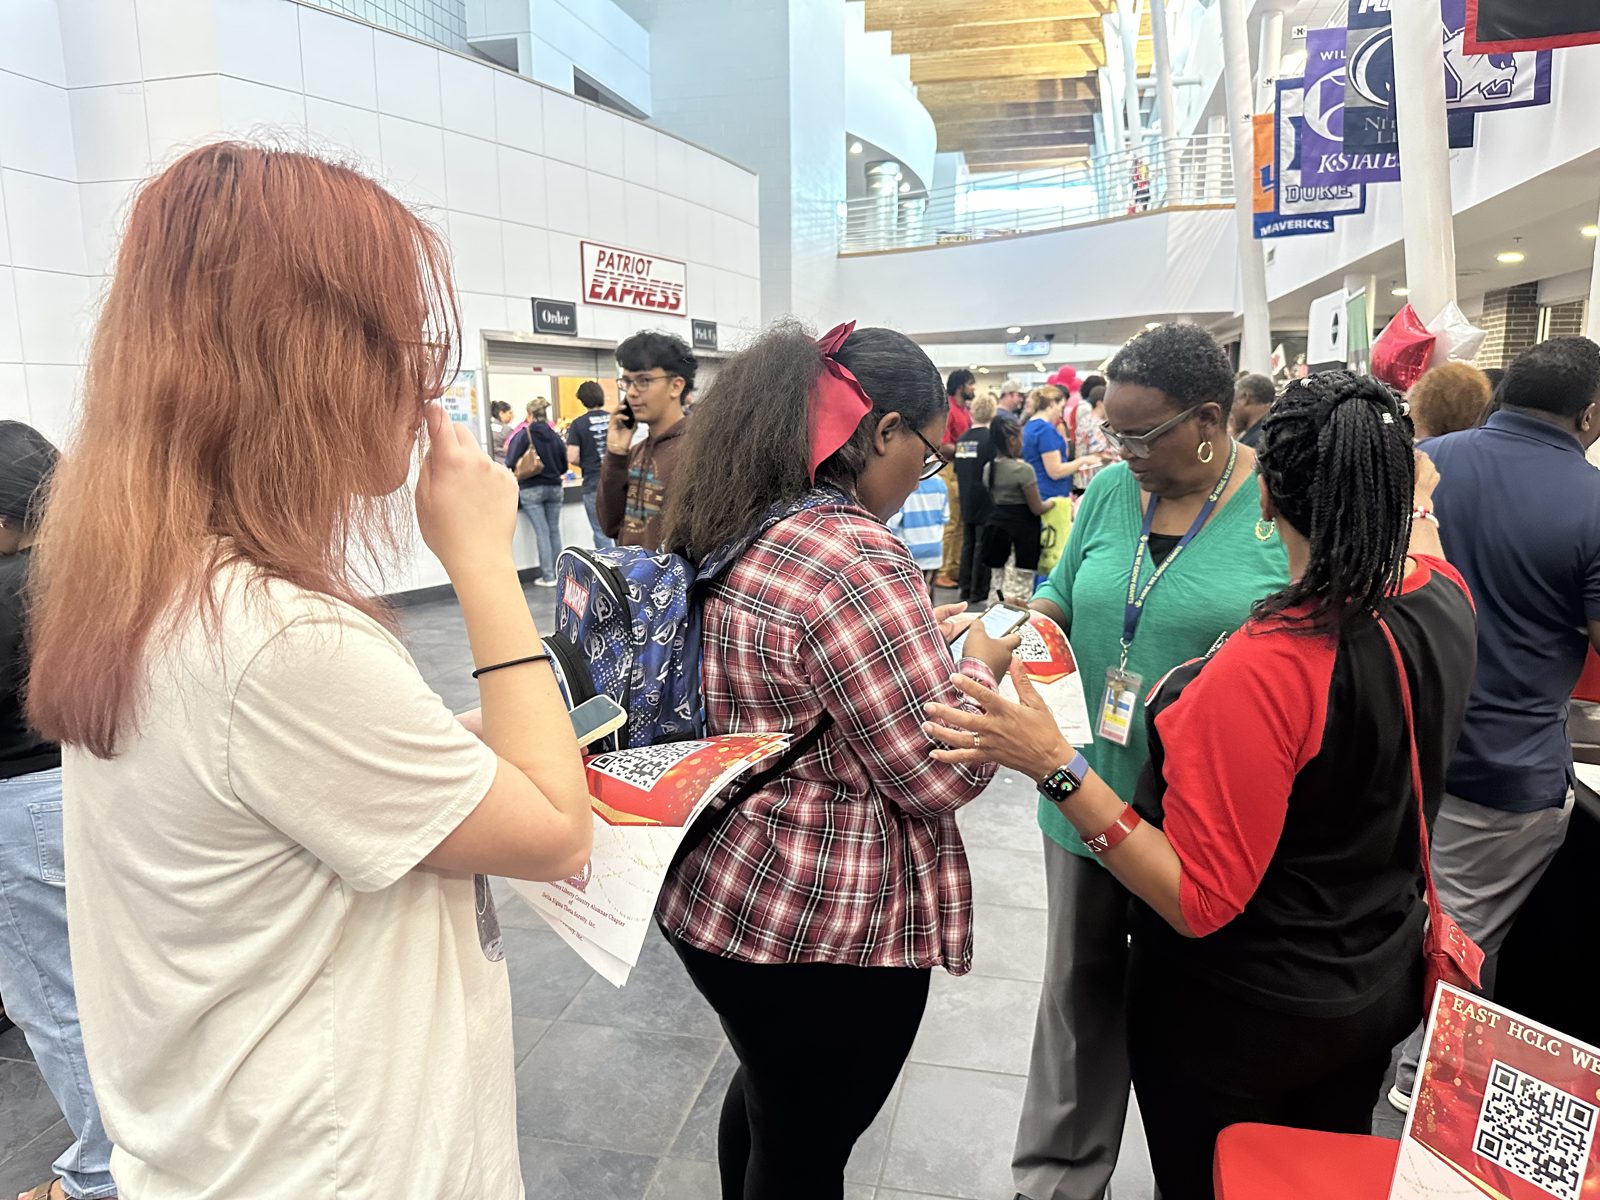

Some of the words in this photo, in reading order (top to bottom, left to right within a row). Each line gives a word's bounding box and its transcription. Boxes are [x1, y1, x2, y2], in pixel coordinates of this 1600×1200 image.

[1285, 184, 1353, 203] DUKE
[1260, 219, 1330, 236] MAVERICKS
[596, 250, 653, 276] PATRIOT
[589, 269, 683, 310] EXPRESS
[542, 309, 571, 325] Order
[1452, 997, 1500, 1028] EAST
[1507, 1021, 1561, 1056] HCLC
